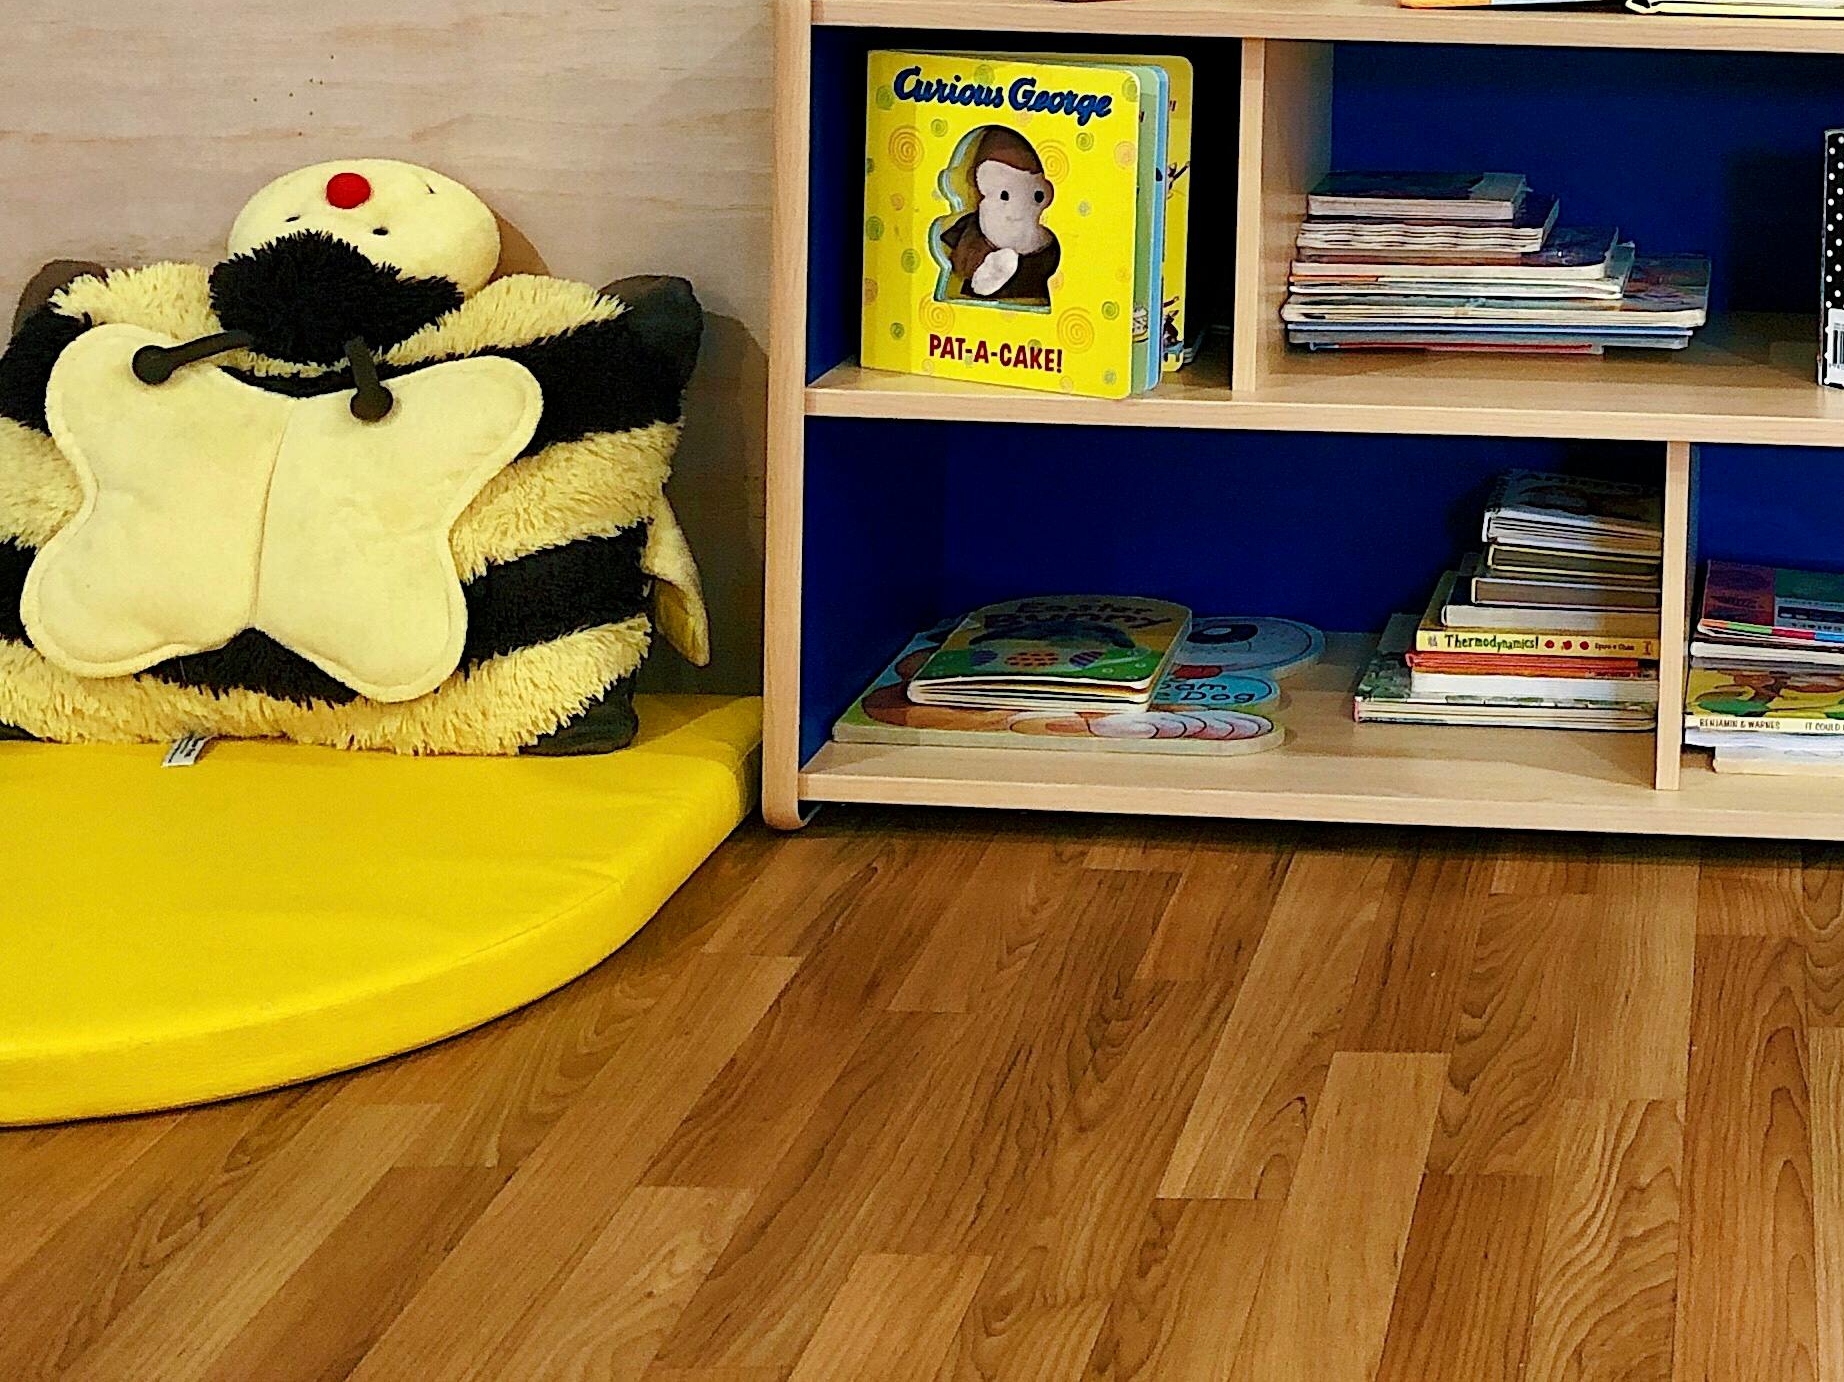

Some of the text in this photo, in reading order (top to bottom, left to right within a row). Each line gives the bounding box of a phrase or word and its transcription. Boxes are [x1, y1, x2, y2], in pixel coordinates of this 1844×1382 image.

[893, 65, 1113, 126] Curious George
[928, 333, 1063, 374] PAT-A-CAKE!
[1444, 633, 1540, 653] Thermodynamics!
[1180, 690, 1256, 704] Dog
[1805, 721, 1813, 731] IT
[1815, 722, 1841, 732] COULD
